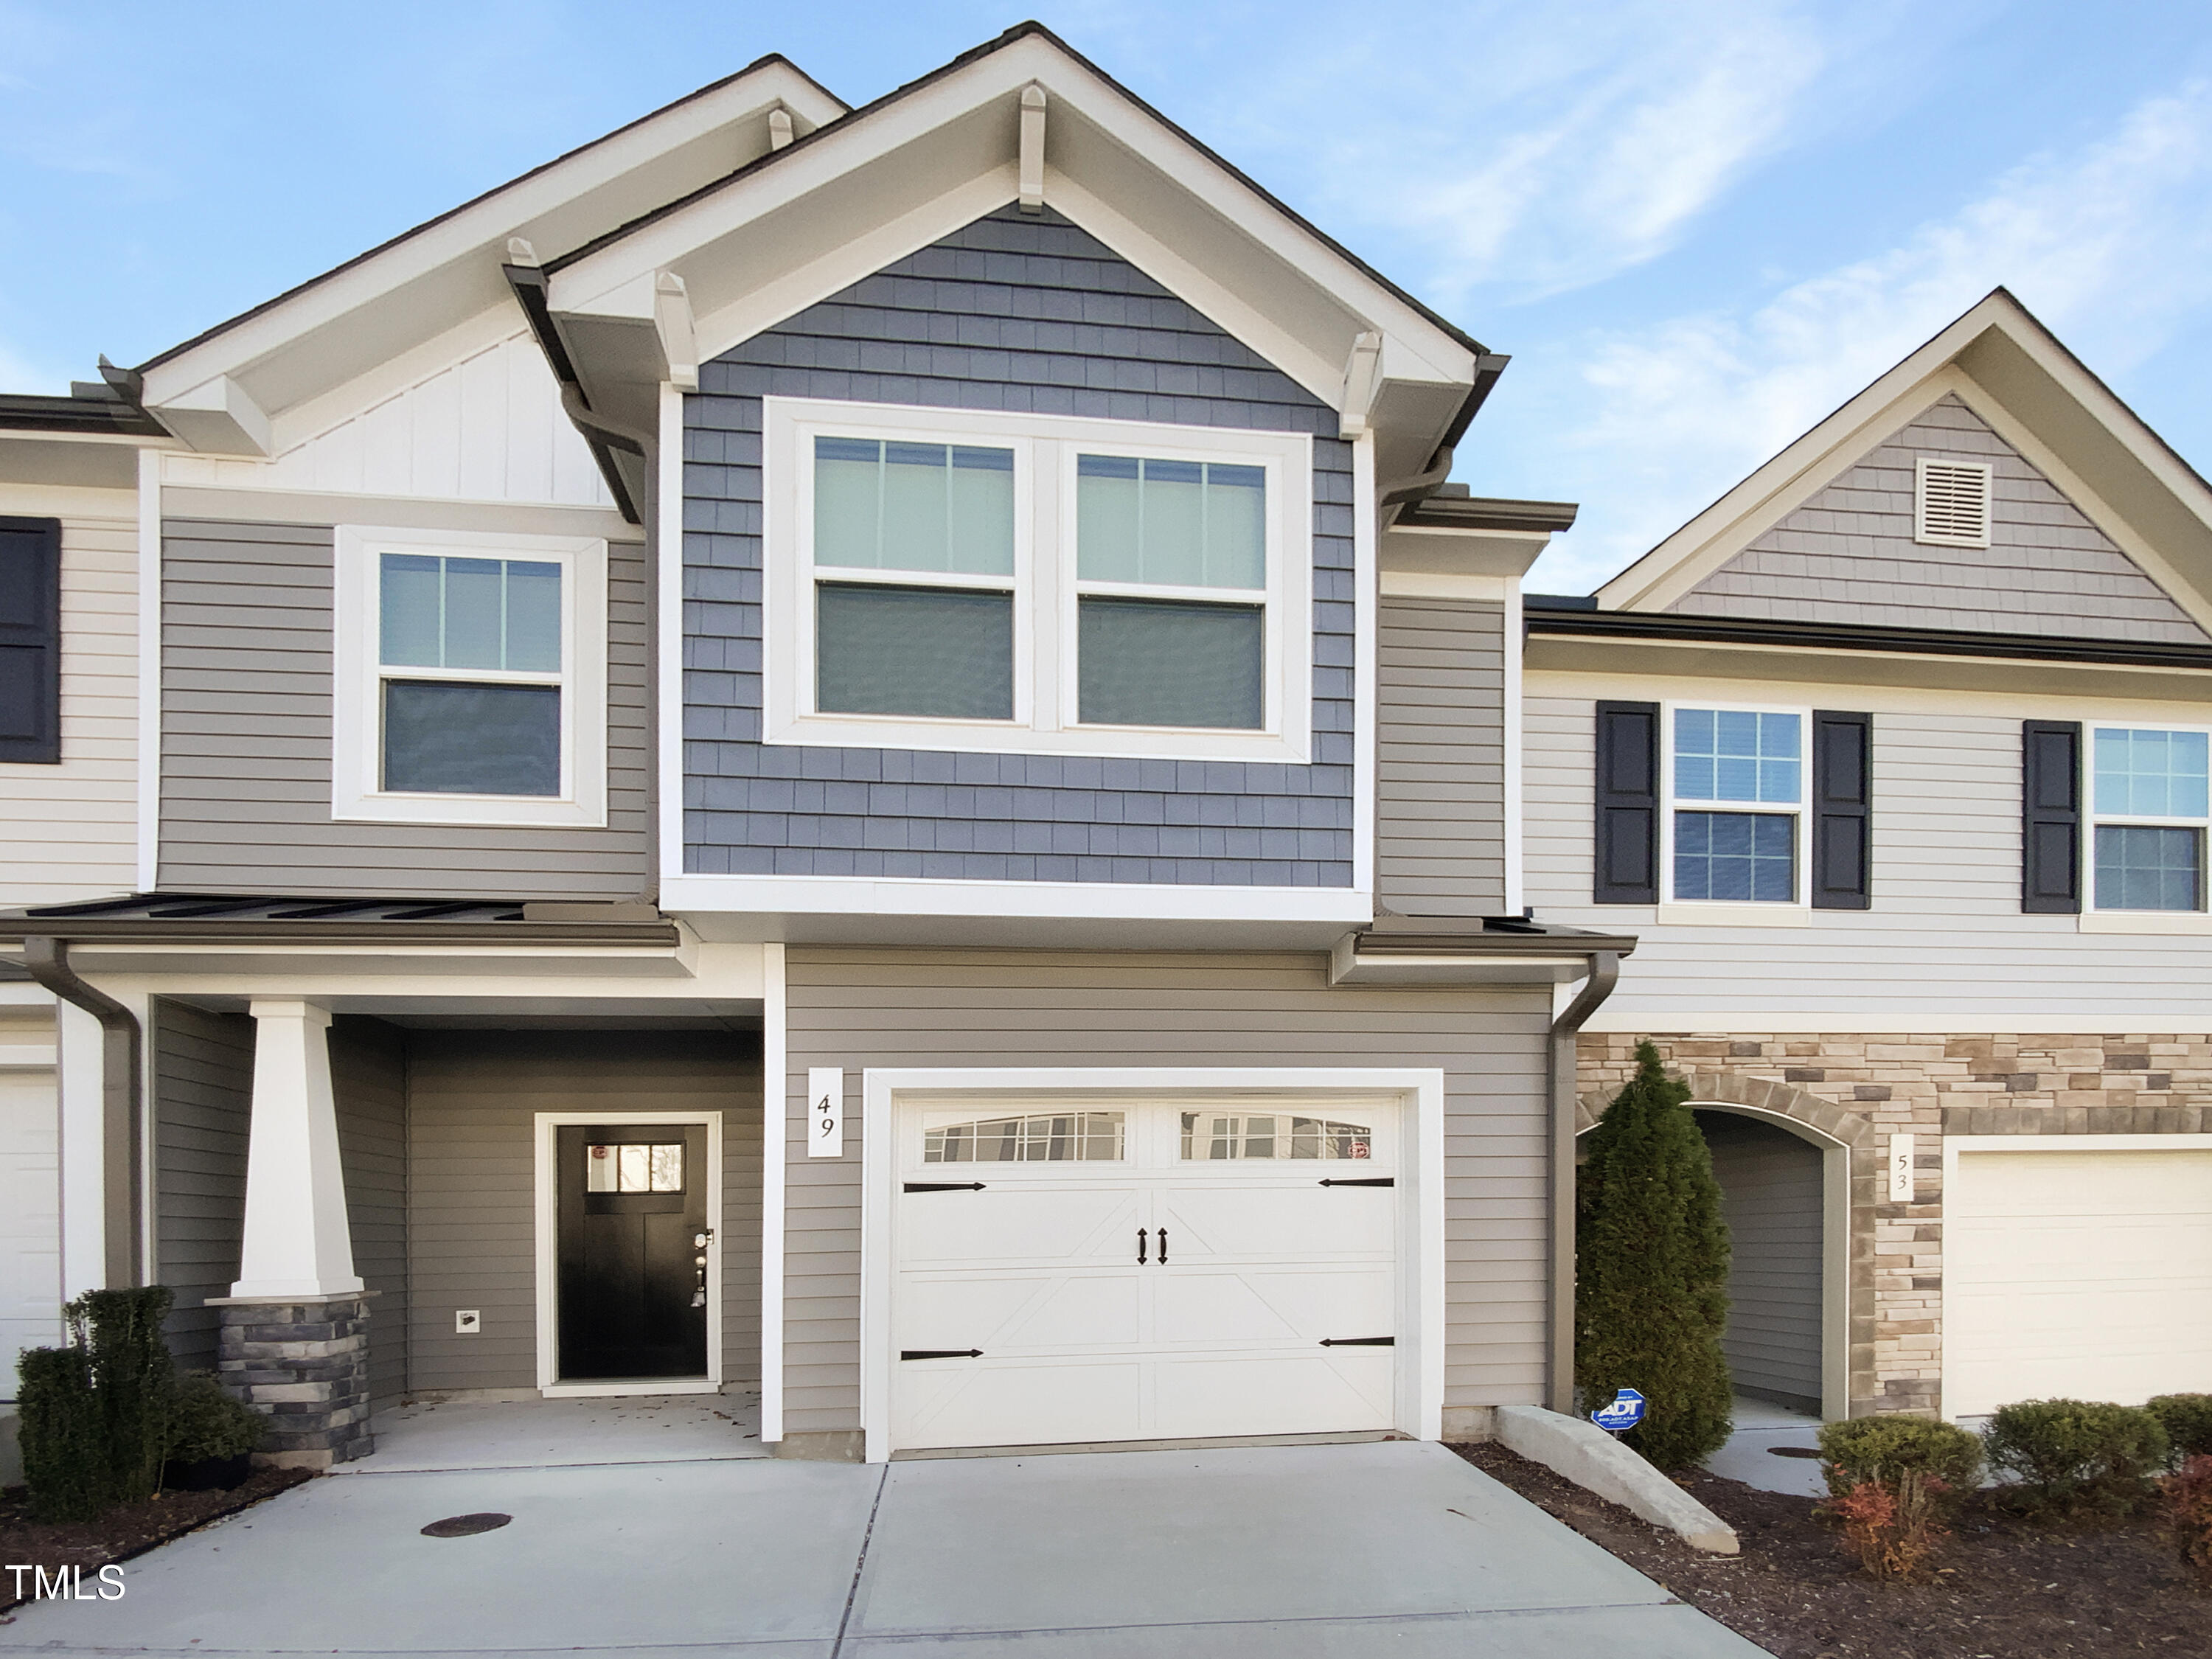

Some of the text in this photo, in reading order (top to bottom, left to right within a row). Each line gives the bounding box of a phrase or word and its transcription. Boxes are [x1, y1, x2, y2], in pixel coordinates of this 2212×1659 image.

[818, 1094, 834, 1138] 49
[1898, 1155, 1907, 1190] 53
[1598, 1399, 1642, 1416] ADT
